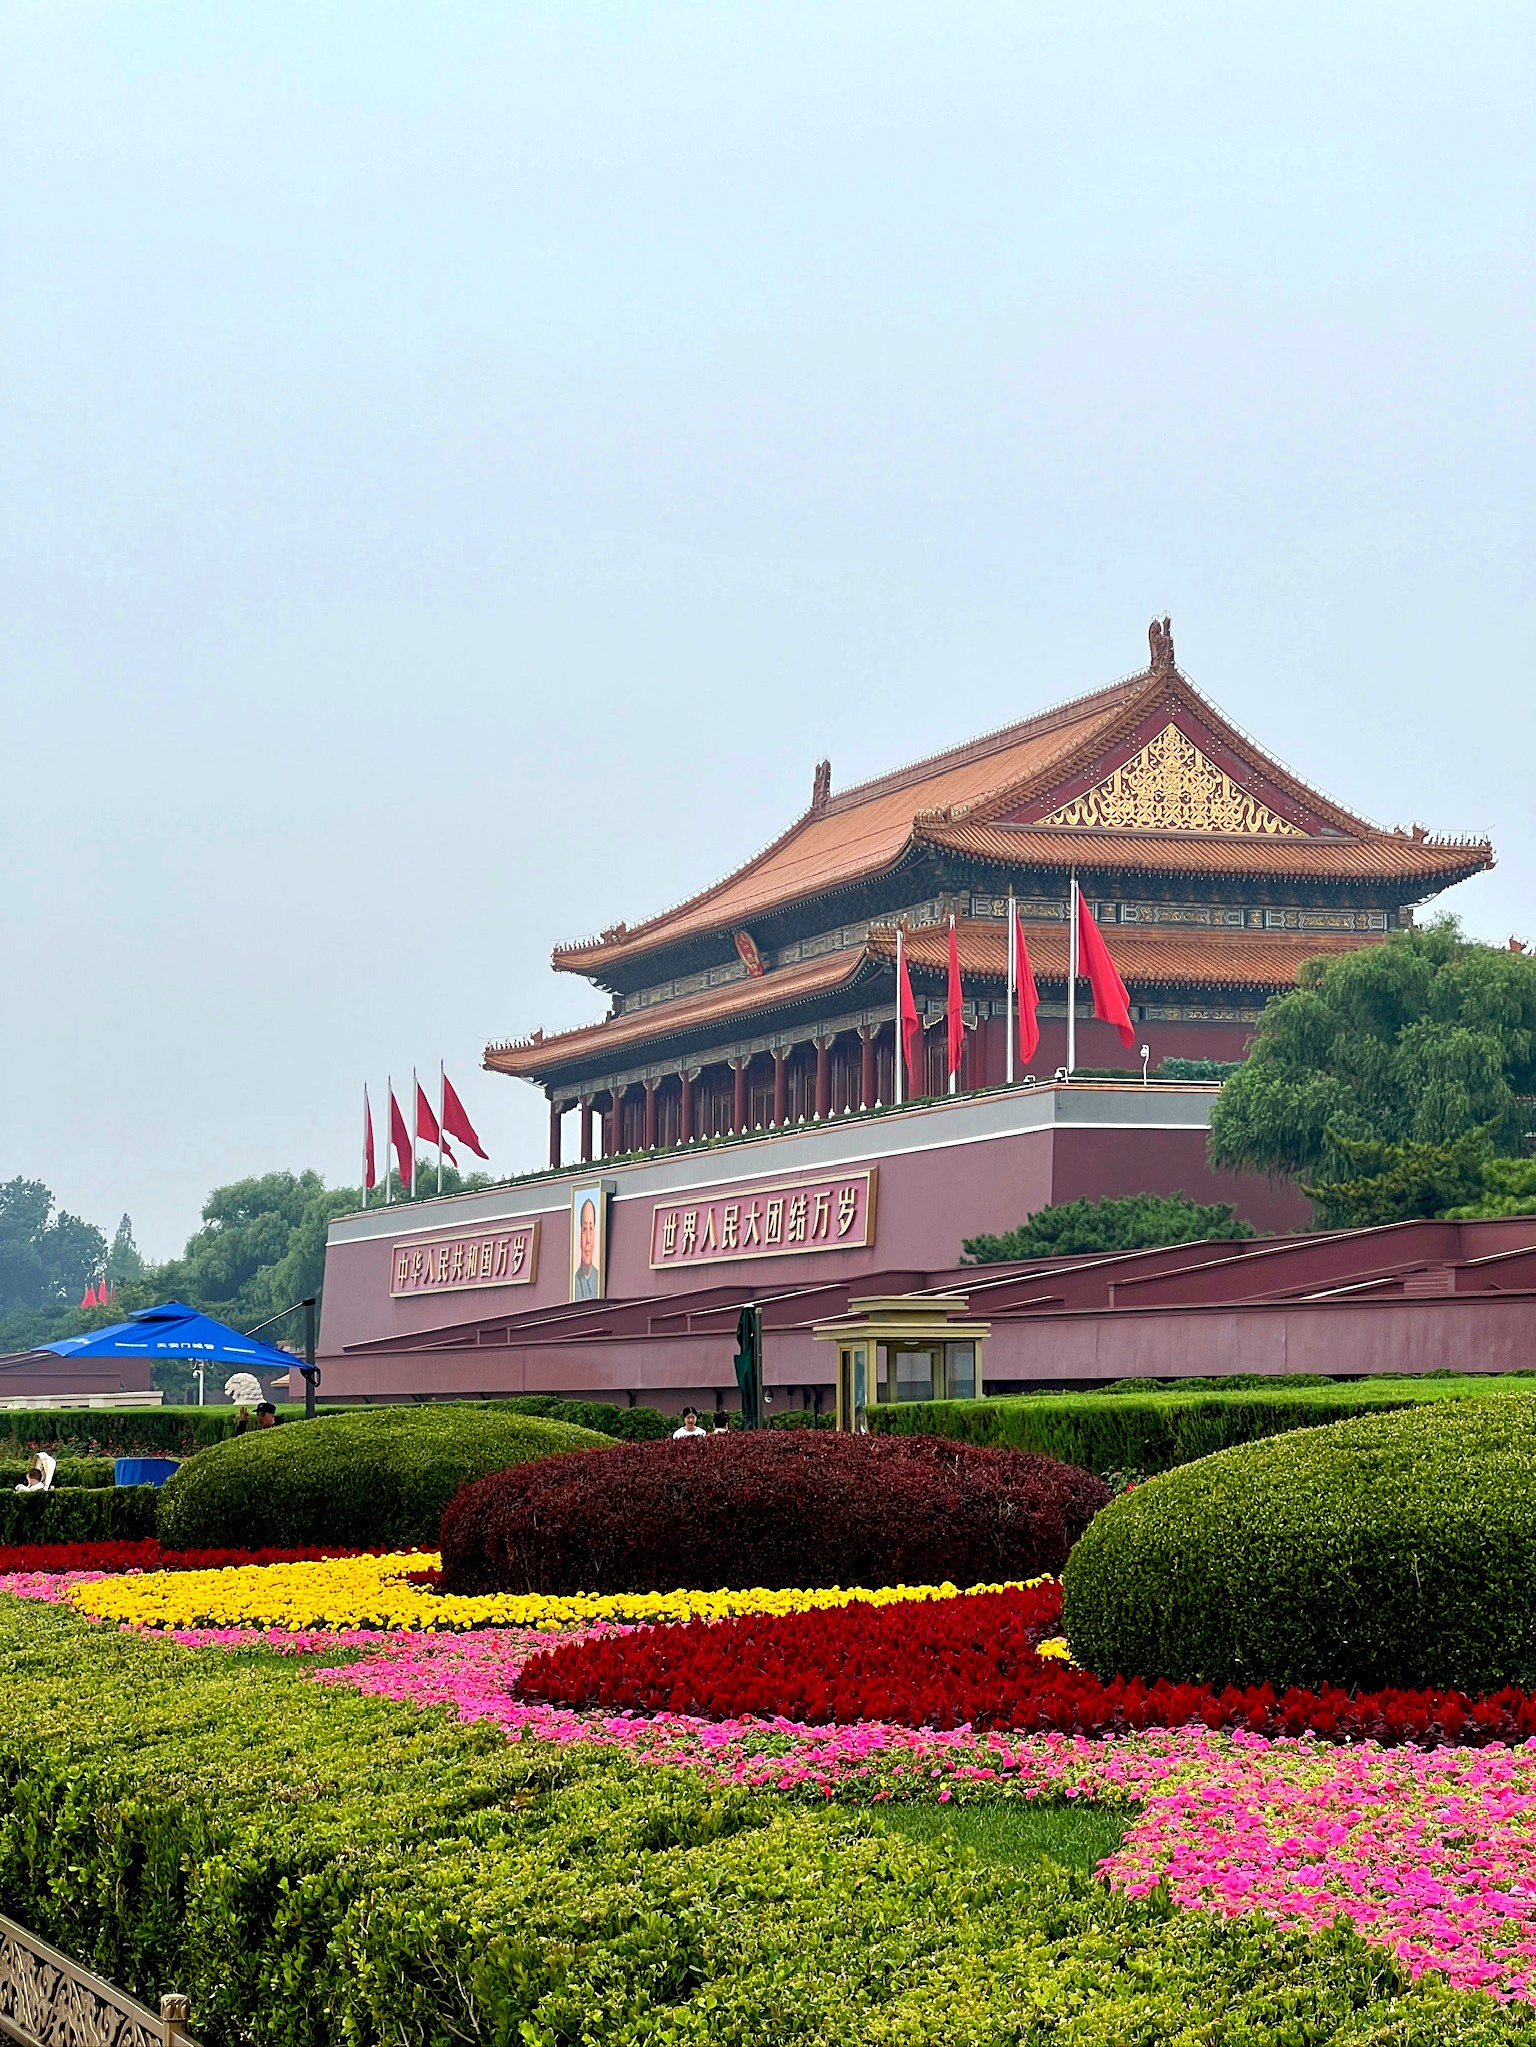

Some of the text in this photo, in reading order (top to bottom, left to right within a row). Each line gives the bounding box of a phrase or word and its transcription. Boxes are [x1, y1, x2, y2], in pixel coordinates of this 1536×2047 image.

[662, 1186, 856, 1256] 世界人民大团结万岁
[397, 1235, 527, 1288] 中华人民共和国万岁
